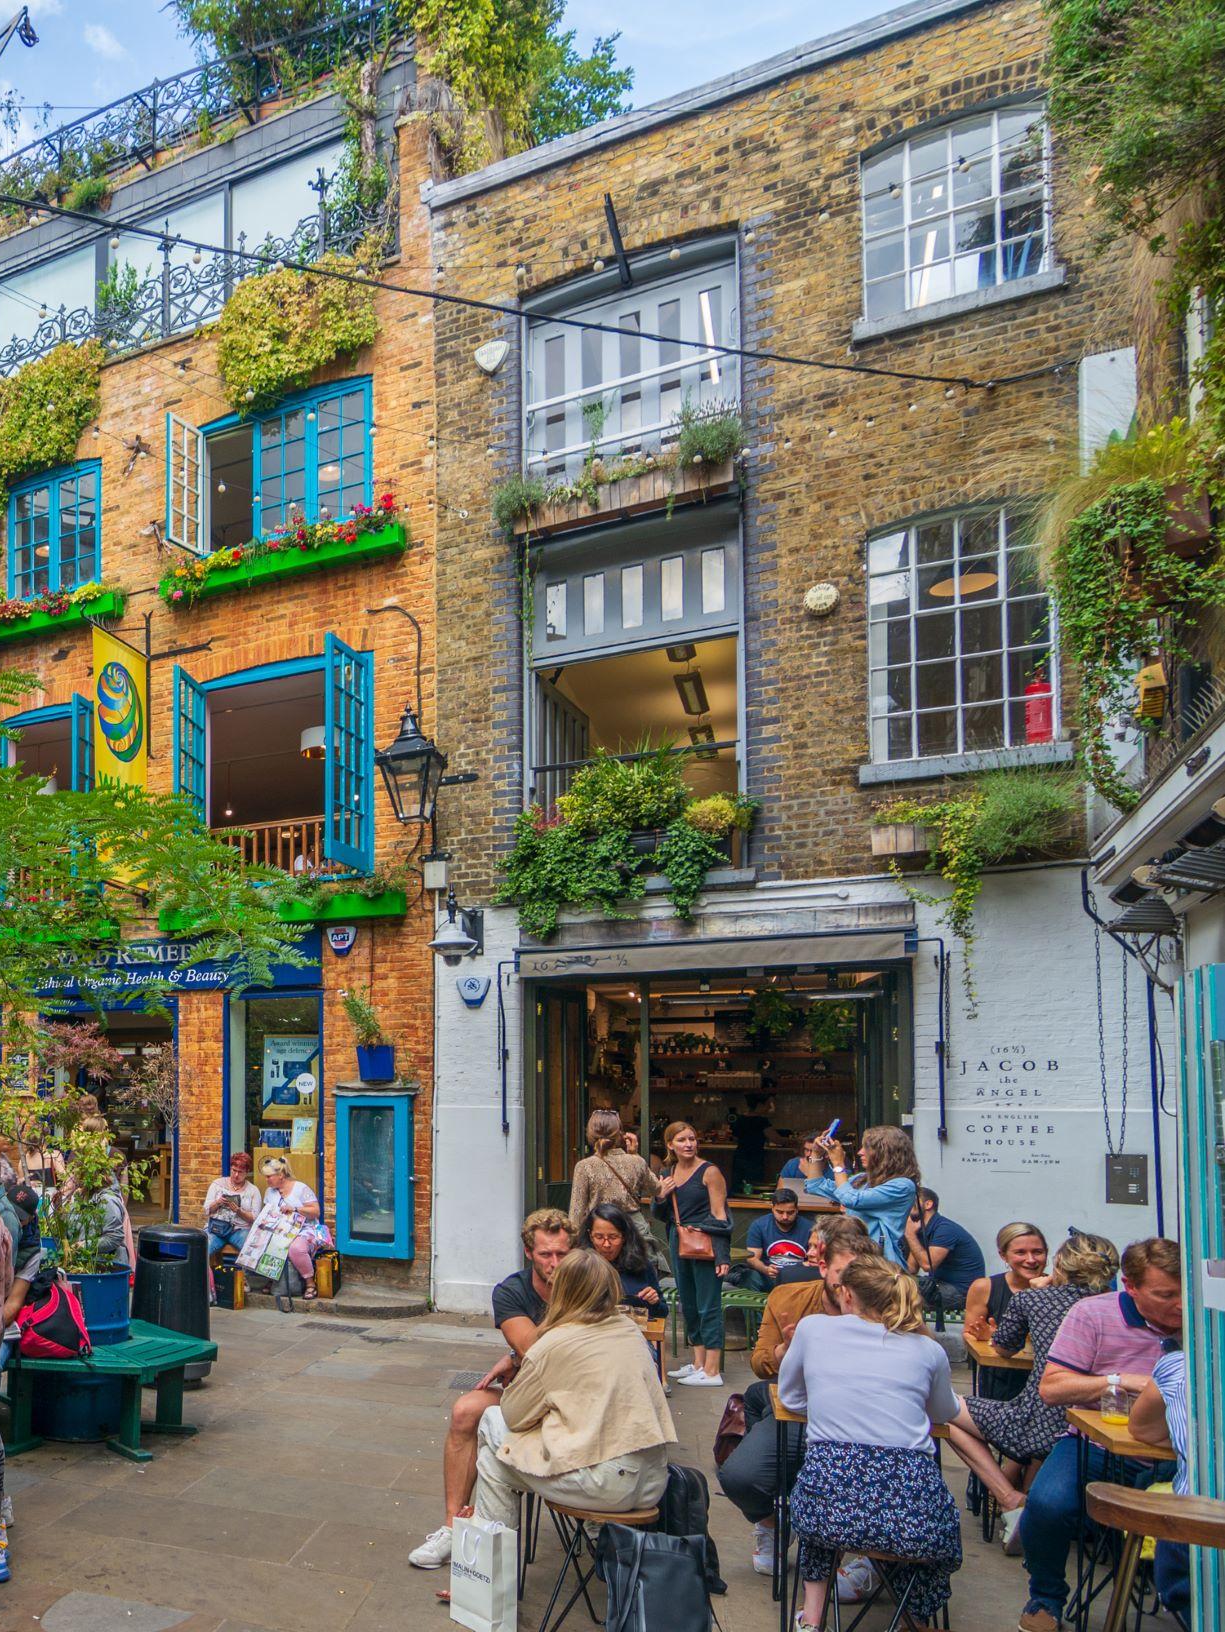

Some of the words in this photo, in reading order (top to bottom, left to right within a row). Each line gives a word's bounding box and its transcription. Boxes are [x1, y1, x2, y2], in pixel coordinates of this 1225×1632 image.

[332, 933, 349, 941] APT
[533, 961, 548, 971] 16
[124, 971, 164, 985] Health
[168, 970, 182, 982] &
[185, 969, 229, 983] Beauty
[960, 1060, 1060, 1076] JACOB
[1000, 1076, 1018, 1084] the
[976, 1088, 1042, 1097] ANGEL
[966, 1124, 1055, 1134] COFFEE
